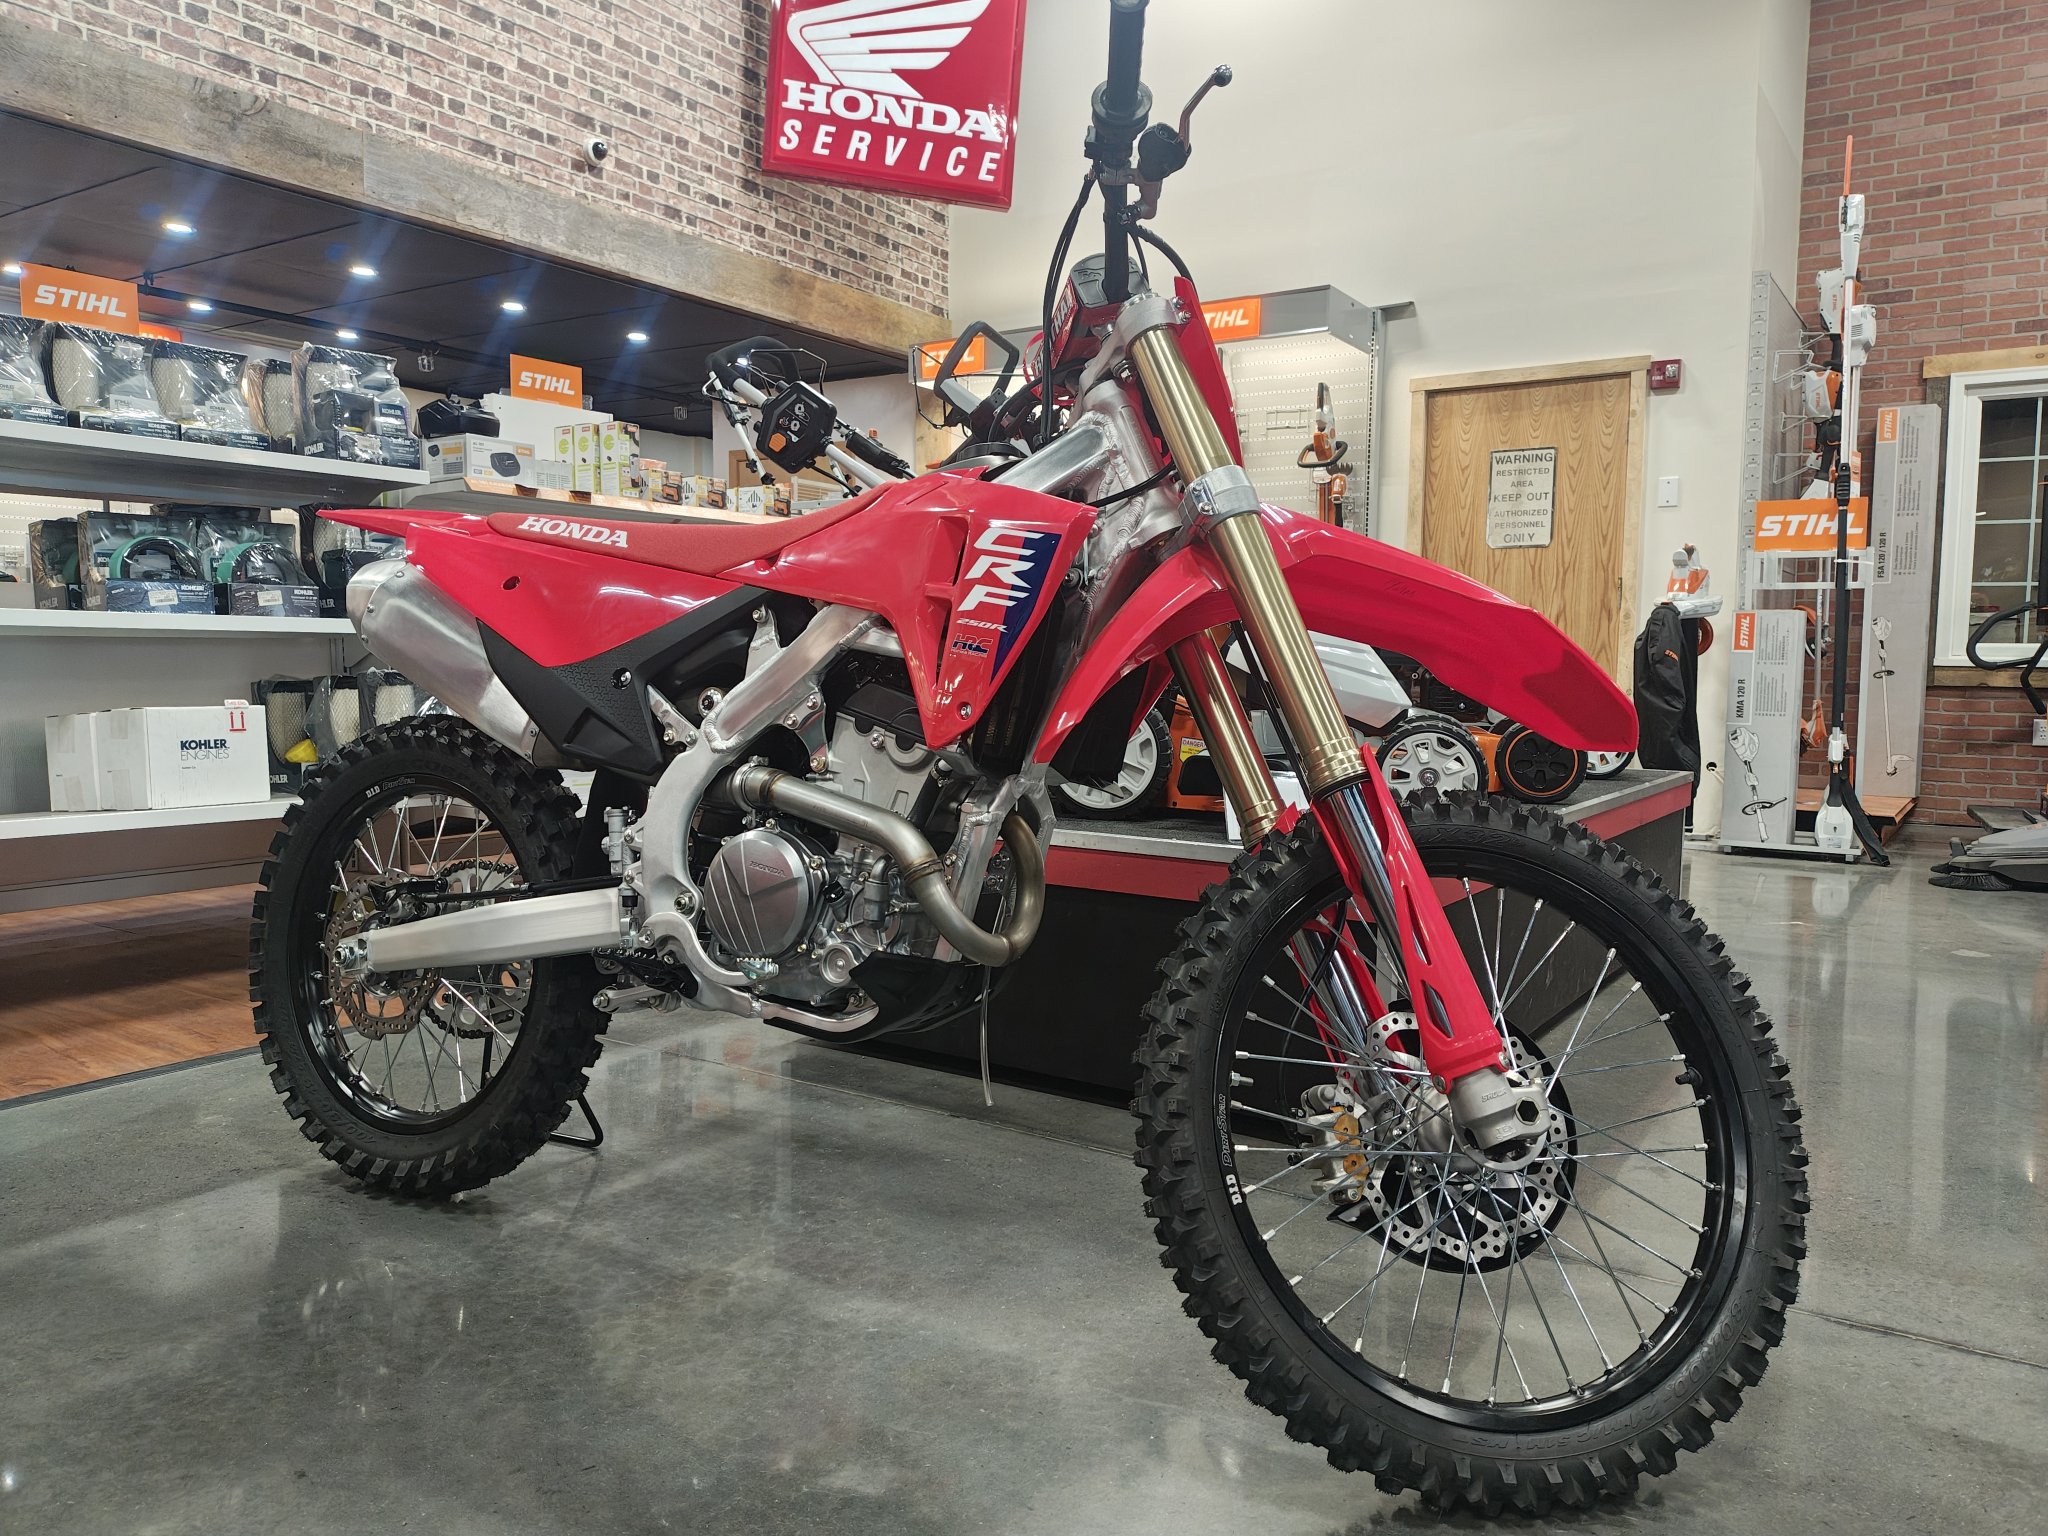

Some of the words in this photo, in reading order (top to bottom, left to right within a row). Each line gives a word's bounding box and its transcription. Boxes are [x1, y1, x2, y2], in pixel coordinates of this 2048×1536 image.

[782, 79, 1003, 143] HONDA
[779, 119, 1001, 182] SERVICE
[34, 284, 127, 318] STIHL
[1203, 309, 1249, 328] TIHL
[518, 371, 575, 395] STIHL
[1884, 412, 1893, 440] STIHL
[304, 442, 325, 456] KOHLER
[1494, 452, 1554, 465] WARNING
[1496, 467, 1550, 477] RESTRICTED
[1510, 480, 1534, 488] AREA
[1493, 493, 1522, 503] KEEP
[1526, 492, 1550, 501] OUT
[1494, 508, 1549, 518] AUTHORIZED
[518, 516, 628, 548] HONDA
[1494, 521, 1546, 530] PERSONNEL
[1758, 513, 1864, 537] STIHL
[956, 527, 1045, 612] CRF
[1877, 566, 1885, 579] FSA
[319, 598, 335, 608] HLER
[956, 617, 1009, 633] 250R
[1740, 616, 1750, 648] STIHL
[1737, 685, 1746, 698] 120
[1736, 700, 1745, 719] KMA
[180, 749, 230, 761] ENGINES
[270, 775, 288, 783] OHLER
